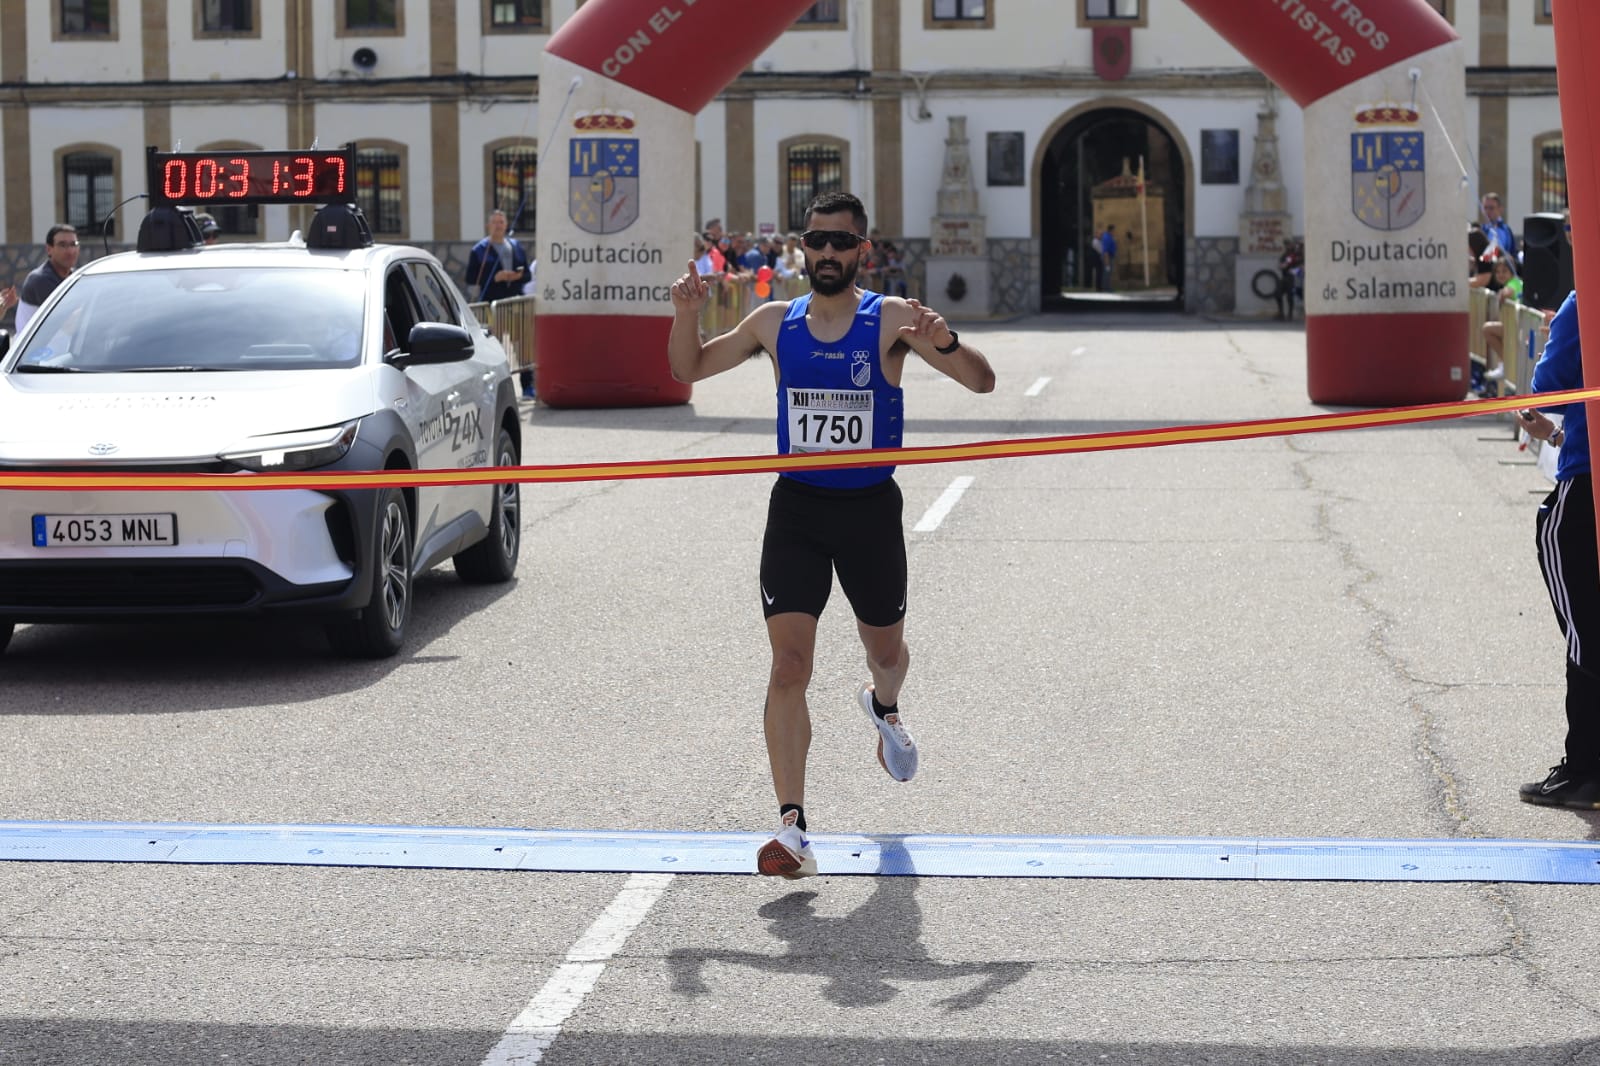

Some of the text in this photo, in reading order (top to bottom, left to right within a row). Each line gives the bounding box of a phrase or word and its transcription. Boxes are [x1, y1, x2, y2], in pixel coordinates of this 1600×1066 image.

[601, 5, 682, 77] CON EL
[1272, 0, 1356, 66] TISTAS
[164, 157, 345, 198] 00:31:37
[550, 241, 663, 268] Diputación
[1331, 237, 1448, 267] Diputación
[543, 278, 671, 301] de Salamanca
[1322, 276, 1456, 301] de Salamanca
[793, 392, 809, 407] XII
[810, 392, 825, 401] SAN
[419, 416, 443, 445] TOYOTA
[798, 413, 863, 444] 1750
[53, 519, 168, 542] 4053 MNL
